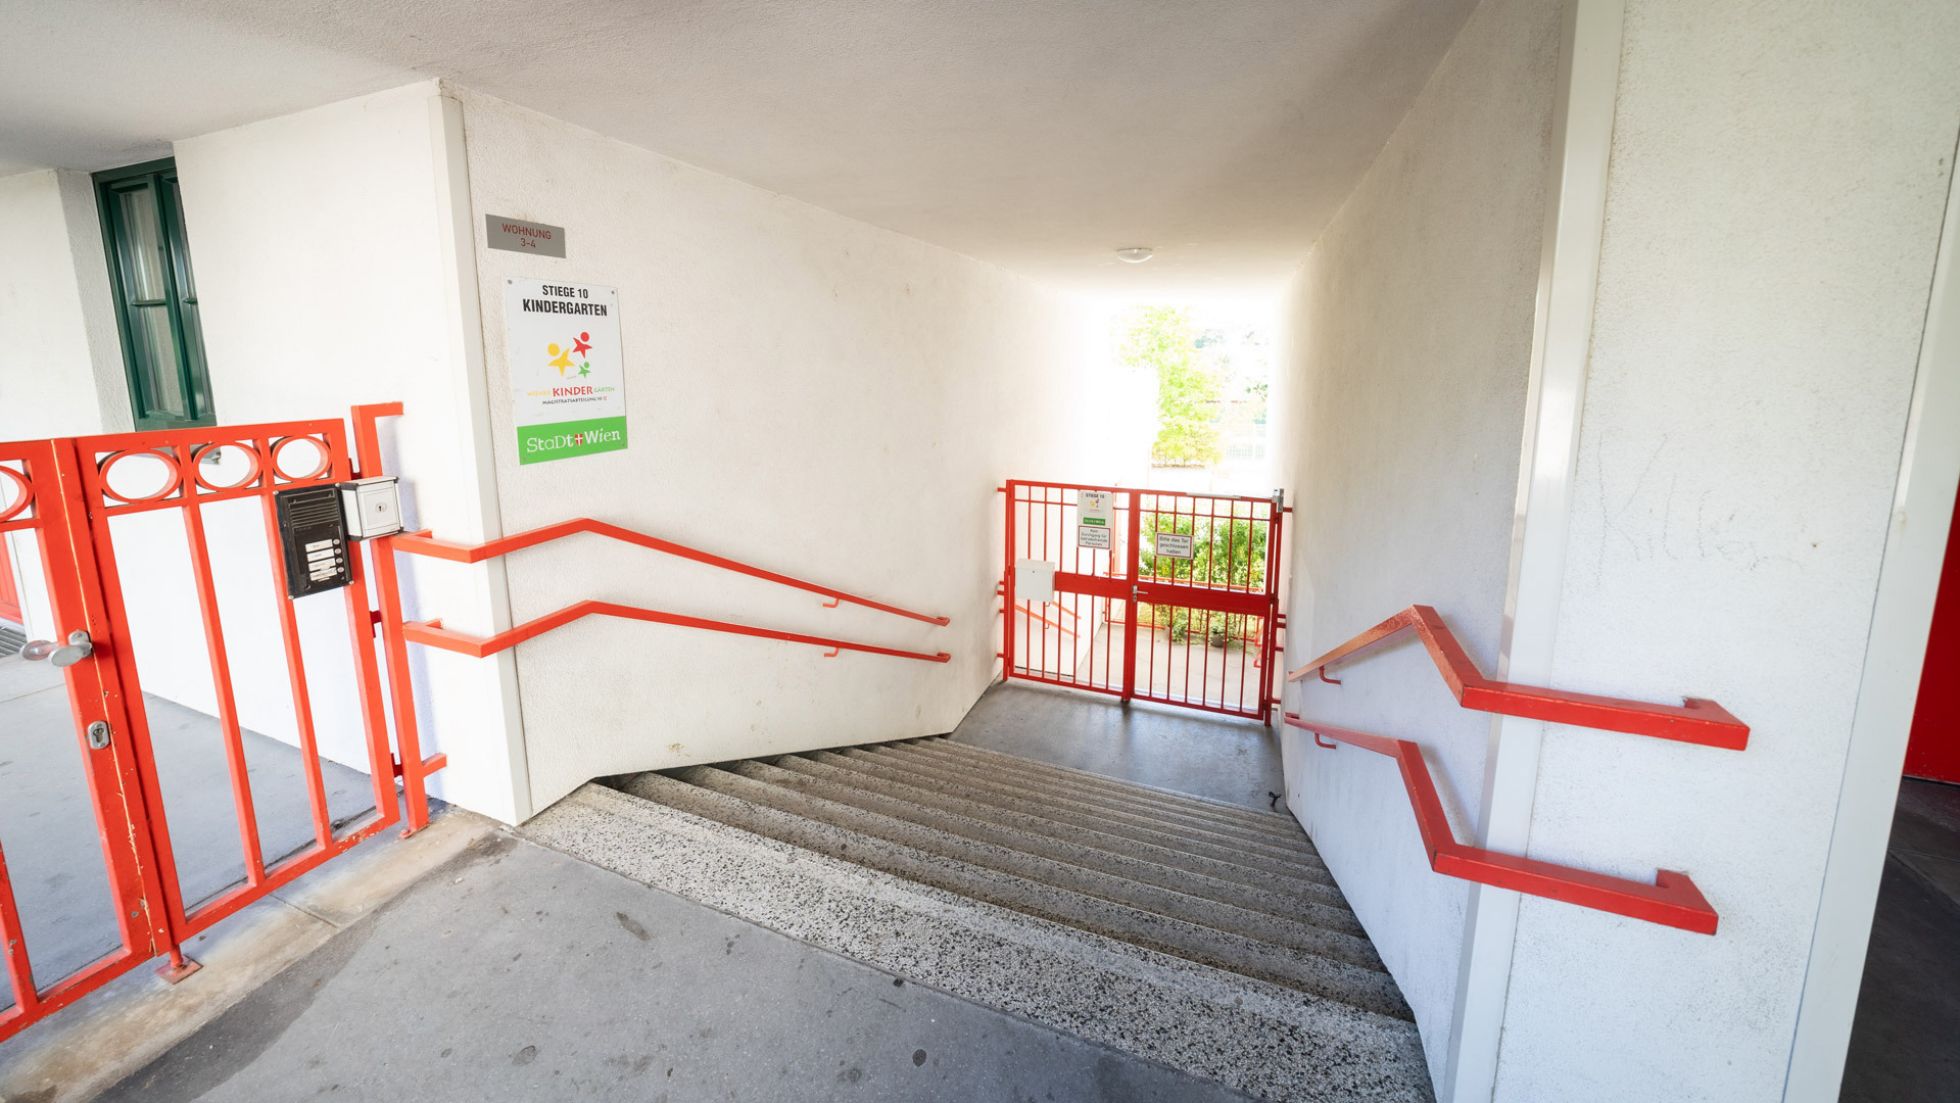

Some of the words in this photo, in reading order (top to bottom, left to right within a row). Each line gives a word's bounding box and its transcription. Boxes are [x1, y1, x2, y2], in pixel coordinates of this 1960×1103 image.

[502, 223, 552, 240] WOHNUNG
[520, 237, 536, 248] 3-4
[542, 285, 575, 298] STIEGE
[577, 288, 589, 299] 10
[522, 298, 607, 316] KINDERGARTEN
[584, 428, 621, 445] Wien
